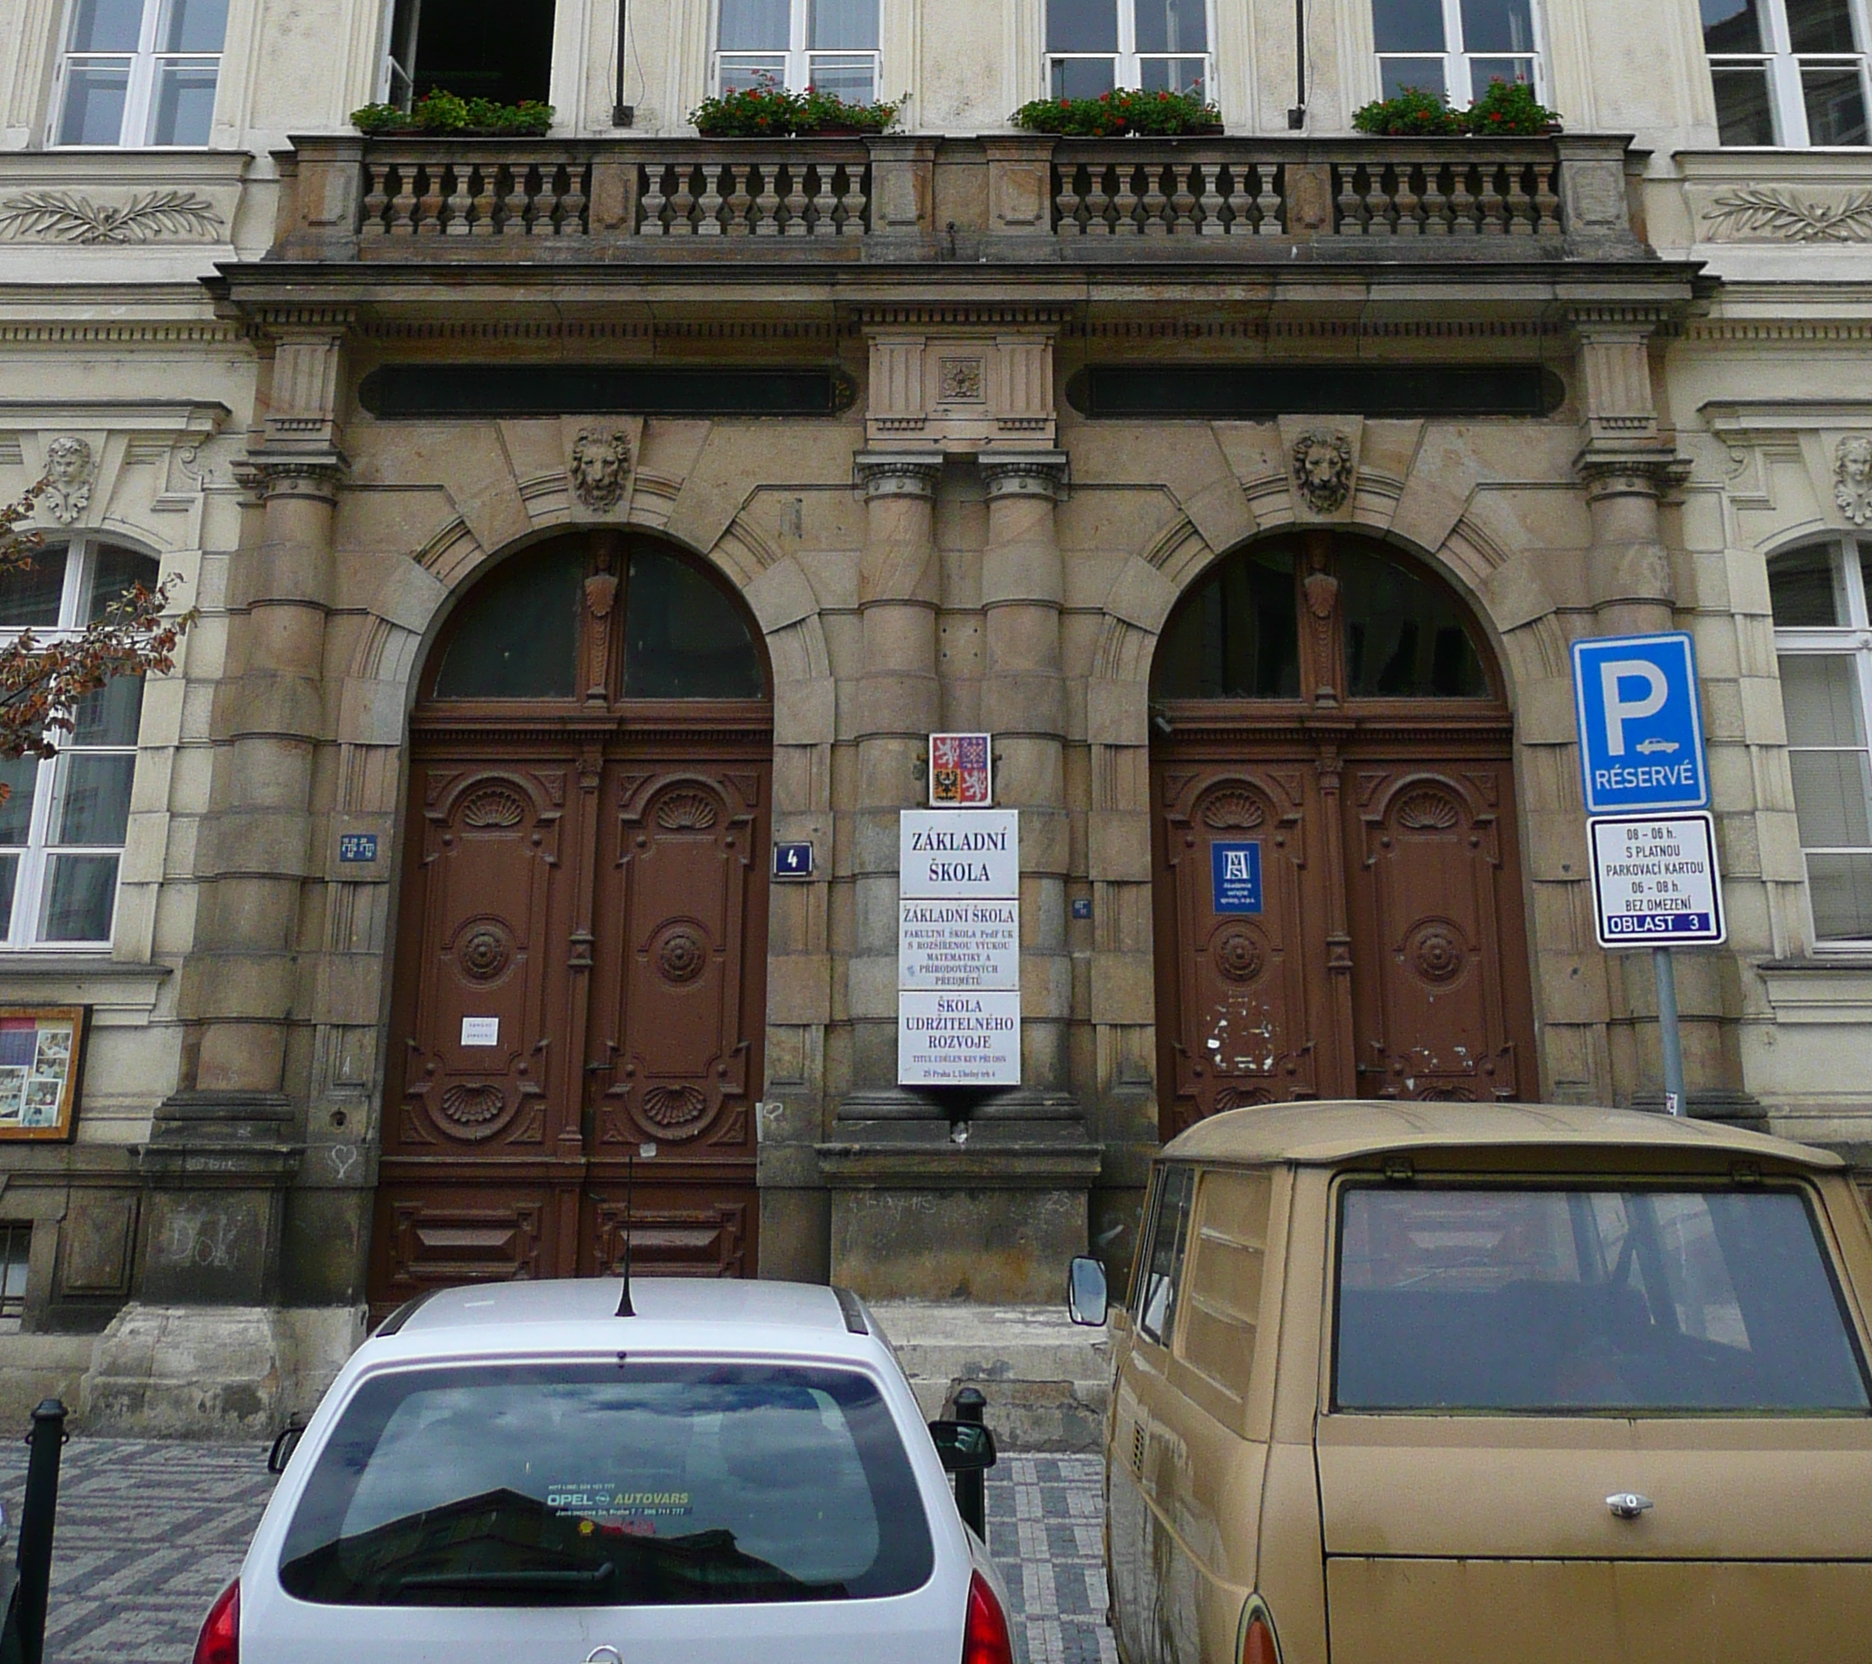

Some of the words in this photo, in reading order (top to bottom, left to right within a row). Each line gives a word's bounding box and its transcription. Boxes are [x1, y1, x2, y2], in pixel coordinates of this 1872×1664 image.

[1600, 659, 1669, 756] P
[1595, 759, 1695, 790] RÉSERVÉ
[912, 826, 1007, 851] ZÁKLADNÍ
[1626, 828, 1639, 841] 08
[1651, 827, 1664, 840] 06
[1666, 826, 1677, 840] h.
[787, 849, 798, 868] 4
[1626, 846, 1633, 858] S
[1635, 844, 1681, 858] PLATNOU
[929, 857, 990, 882] ŠKOLA
[1606, 860, 1662, 876] PARKOVACÍ
[1664, 861, 1704, 875] KARTOU
[1631, 881, 1644, 894] 06
[1656, 880, 1669, 893] 08
[1625, 899, 1644, 912] BEZ
[1647, 895, 1692, 911] OMEZENÍ
[903, 904, 970, 923] ZÁKLADNÍ
[972, 904, 1014, 923] ŠKOLA
[1611, 916, 1674, 932] OBLAST
[1689, 915, 1699, 930] 3
[904, 928, 945, 938] FAKULTNÍ
[949, 928, 976, 938] ŠKOLA
[907, 941, 914, 950] S
[917, 939, 972, 950] ROZŠÍŘENOU
[975, 939, 1011, 950] VÝUKOU
[926, 953, 982, 962] MATEMATIKY
[985, 953, 991, 962] A
[919, 962, 999, 974] PŘÍRODOVĚDNÝCH
[935, 975, 981, 986] PŘEDMĚTŮ
[937, 996, 982, 1013] ŠKOLA
[905, 1013, 1015, 1031] UDRŽITELNÉHO
[928, 1034, 991, 1049] ROZVOJE
[932, 1069, 951, 1078] Praha
[547, 1494, 593, 1506] OPEL
[614, 1492, 689, 1505] AUTOVARS
